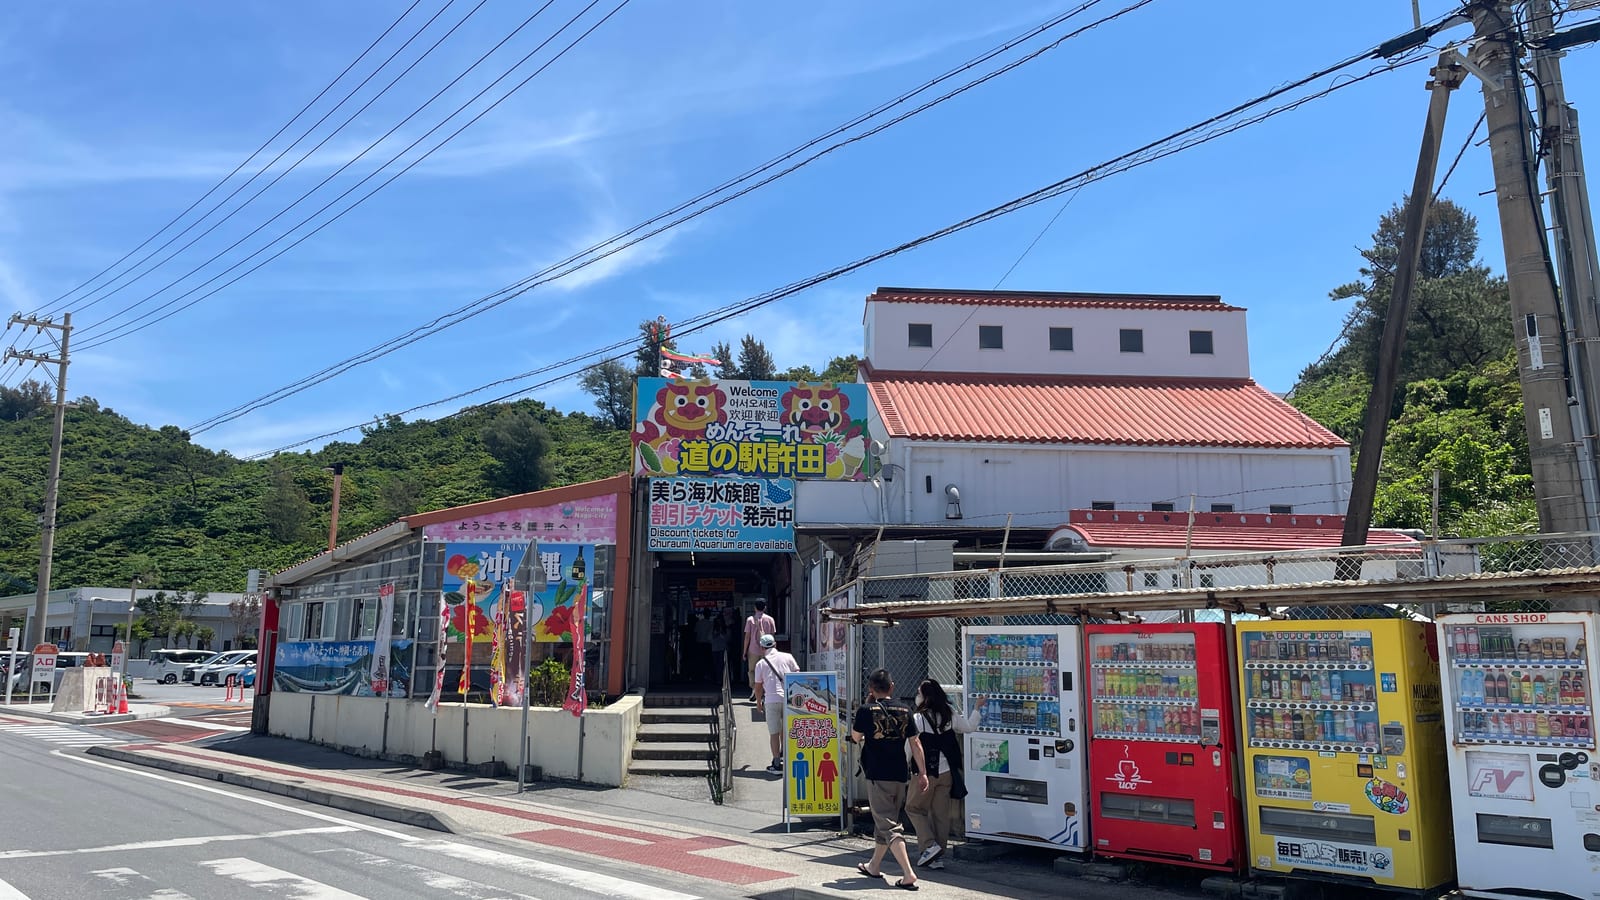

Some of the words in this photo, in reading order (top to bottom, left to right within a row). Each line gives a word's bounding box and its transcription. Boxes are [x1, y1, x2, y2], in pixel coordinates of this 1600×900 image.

[730, 386, 778, 398] Welcome
[730, 399, 777, 409] 어서오세요
[729, 410, 753, 421] 欢迎
[755, 410, 779, 422] 歡迎
[706, 422, 802, 442] めんそーれ
[680, 442, 825, 474] 道の駅許田
[651, 481, 760, 504] 美ら海水族館
[650, 504, 793, 528] 割引チケット発売中
[650, 528, 690, 538] Discount
[692, 529, 724, 538] tickets
[726, 529, 739, 538] for
[650, 539, 691, 549] Churaumi
[693, 539, 735, 550] Aquarium
[753, 540, 793, 550] available
[1476, 614, 1509, 623] CANS
[1513, 614, 1547, 622] SHOP
[807, 702, 826, 712] TOILET
[797, 738, 829, 747] あります
